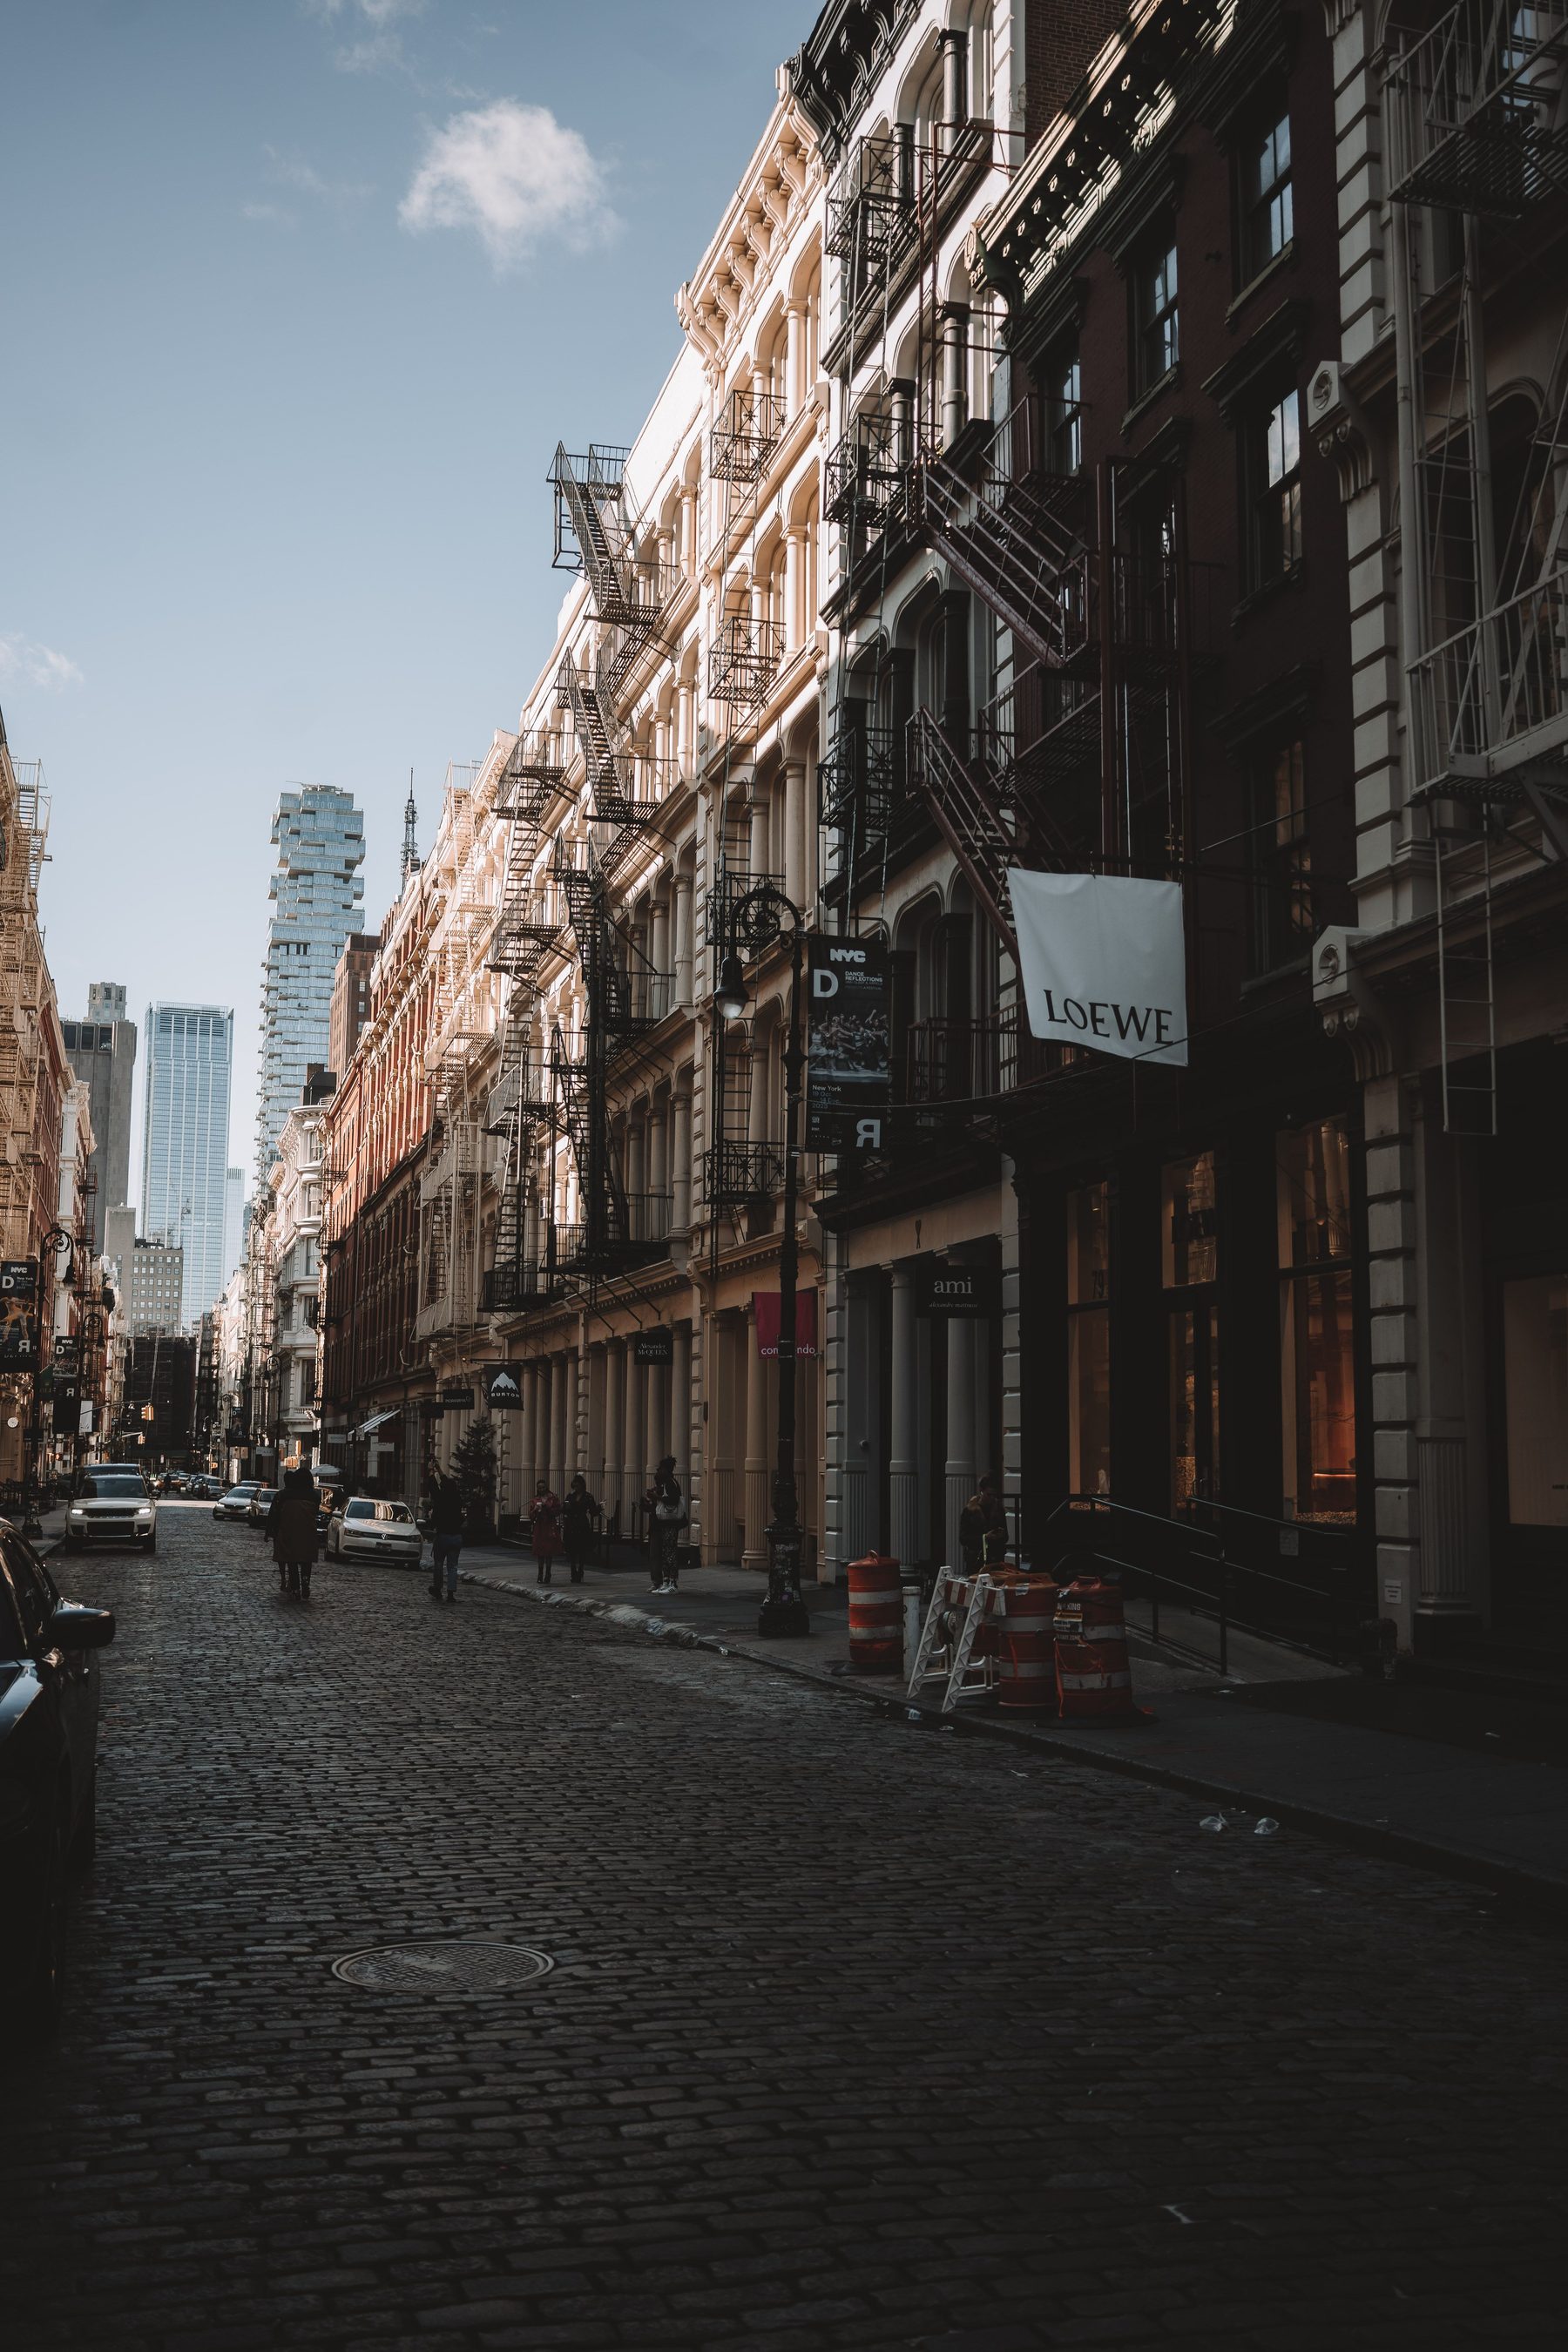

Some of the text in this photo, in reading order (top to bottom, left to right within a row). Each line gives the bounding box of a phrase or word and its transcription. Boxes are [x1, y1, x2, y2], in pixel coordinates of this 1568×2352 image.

[829, 949, 866, 963] NYC
[814, 969, 839, 997] D
[1044, 990, 1173, 1044] LOEWE
[2, 1275, 14, 1289] D
[934, 1276, 973, 1294] ami
